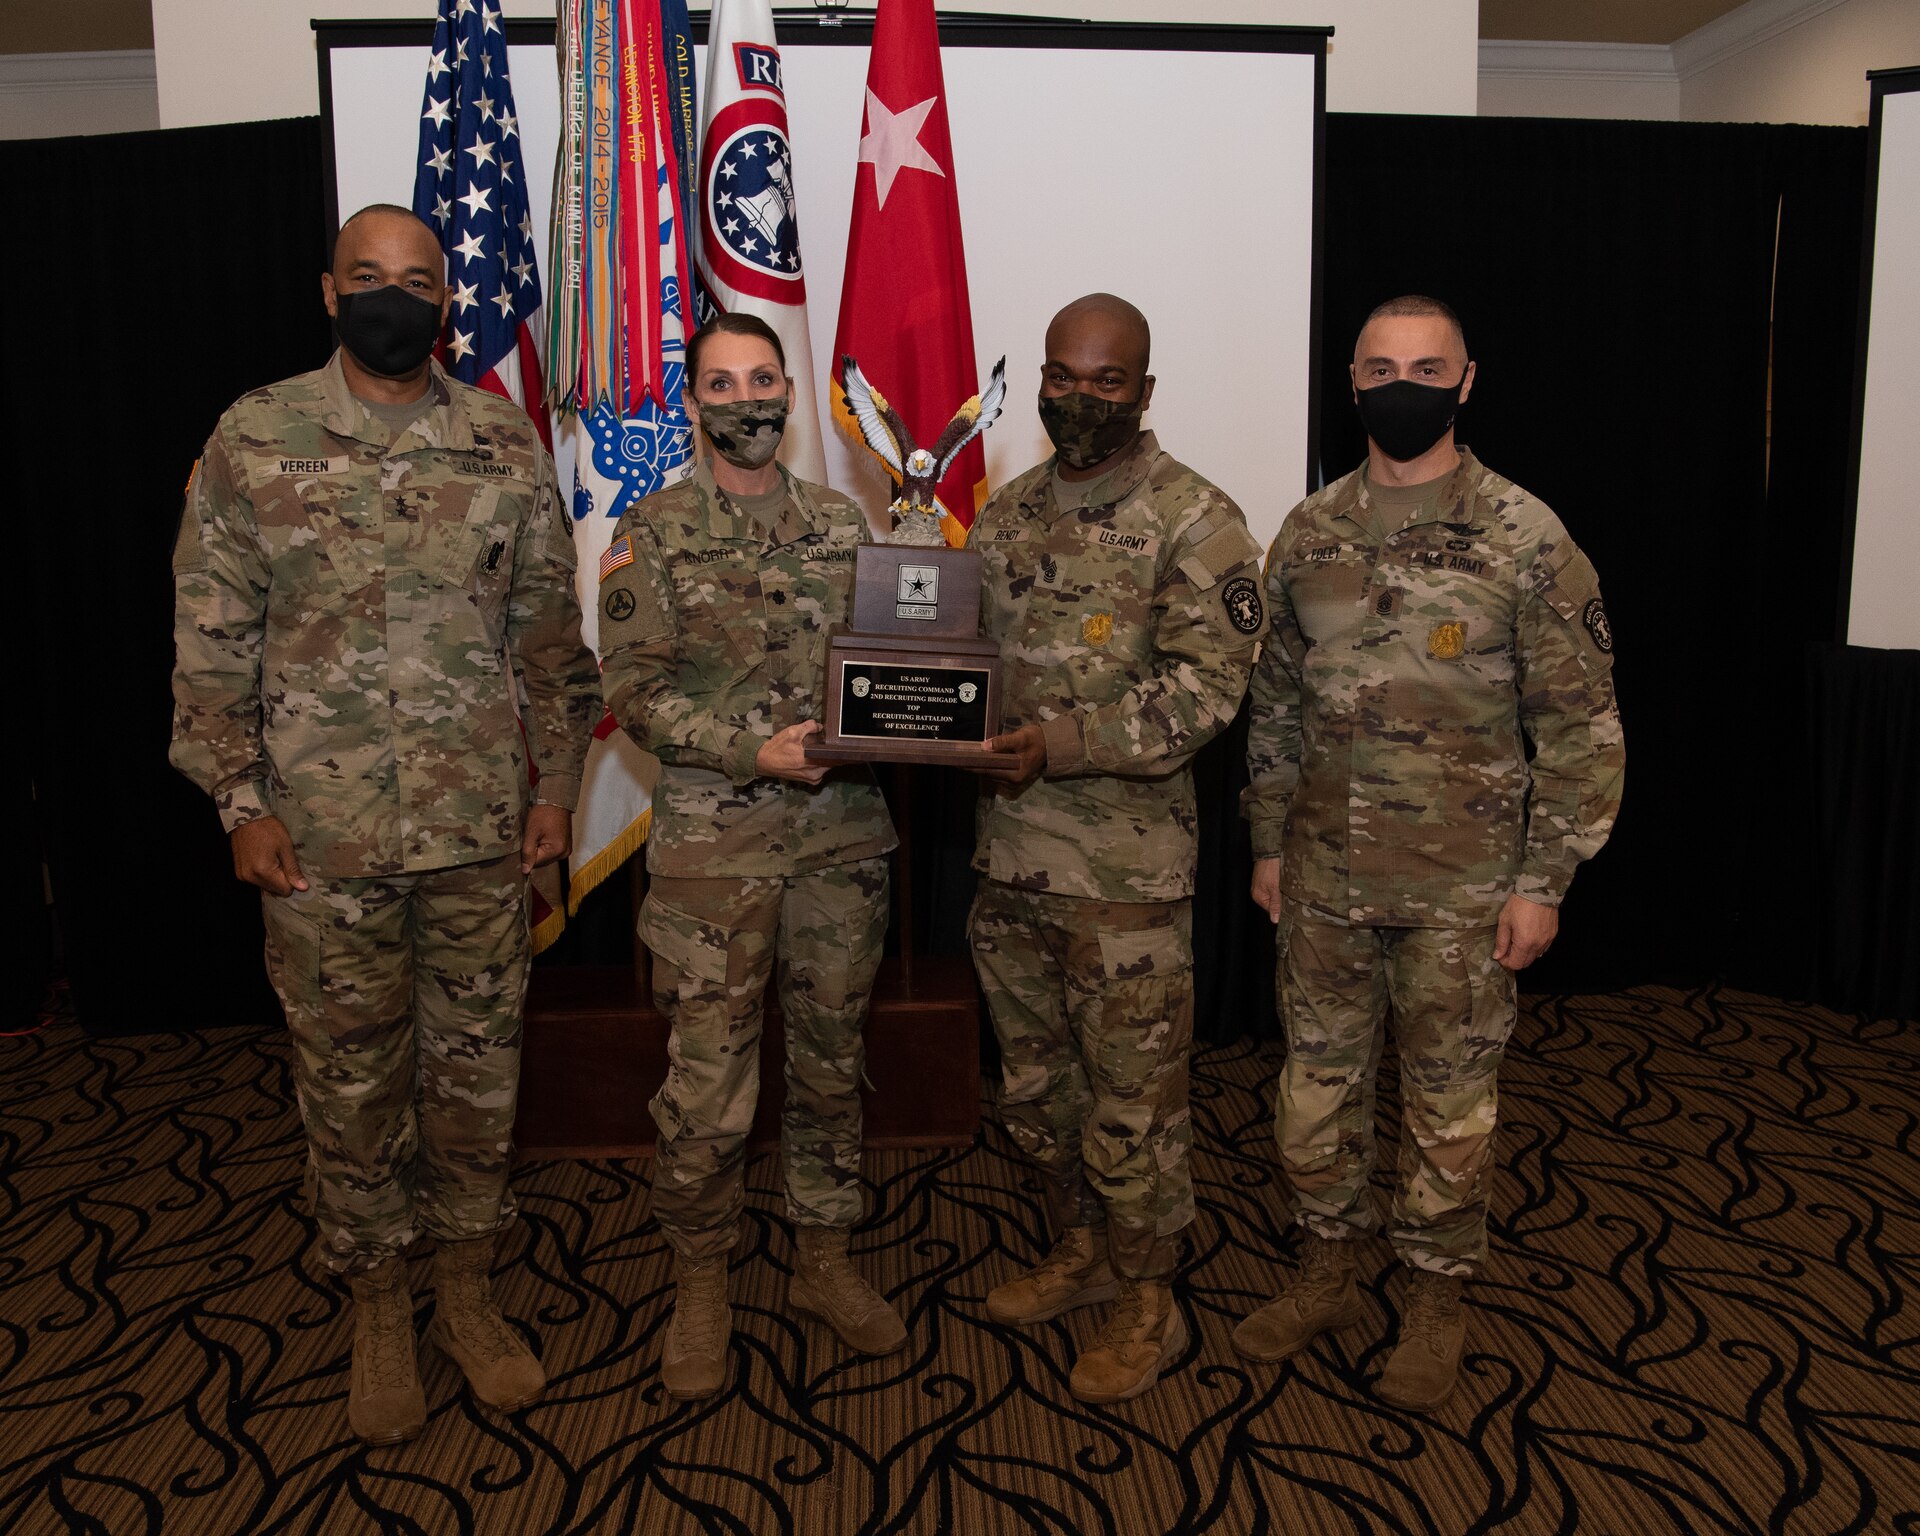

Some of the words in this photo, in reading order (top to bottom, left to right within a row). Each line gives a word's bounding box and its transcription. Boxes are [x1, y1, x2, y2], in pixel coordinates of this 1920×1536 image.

[623, 44, 643, 125] LEXINGTON
[627, 132, 646, 163] 1775
[280, 460, 329, 473] VEREEN
[684, 548, 729, 564] KNORR
[1448, 556, 1486, 575] ARMY
[875, 684, 917, 692] RECRUITING
[918, 686, 954, 694] COMMAND
[884, 694, 926, 702] RECRUITING
[927, 696, 958, 704] BRIGADE
[872, 712, 915, 721] RECRUITING
[915, 714, 954, 722] BATTALION
[895, 723, 940, 732] EXCELLENCE
